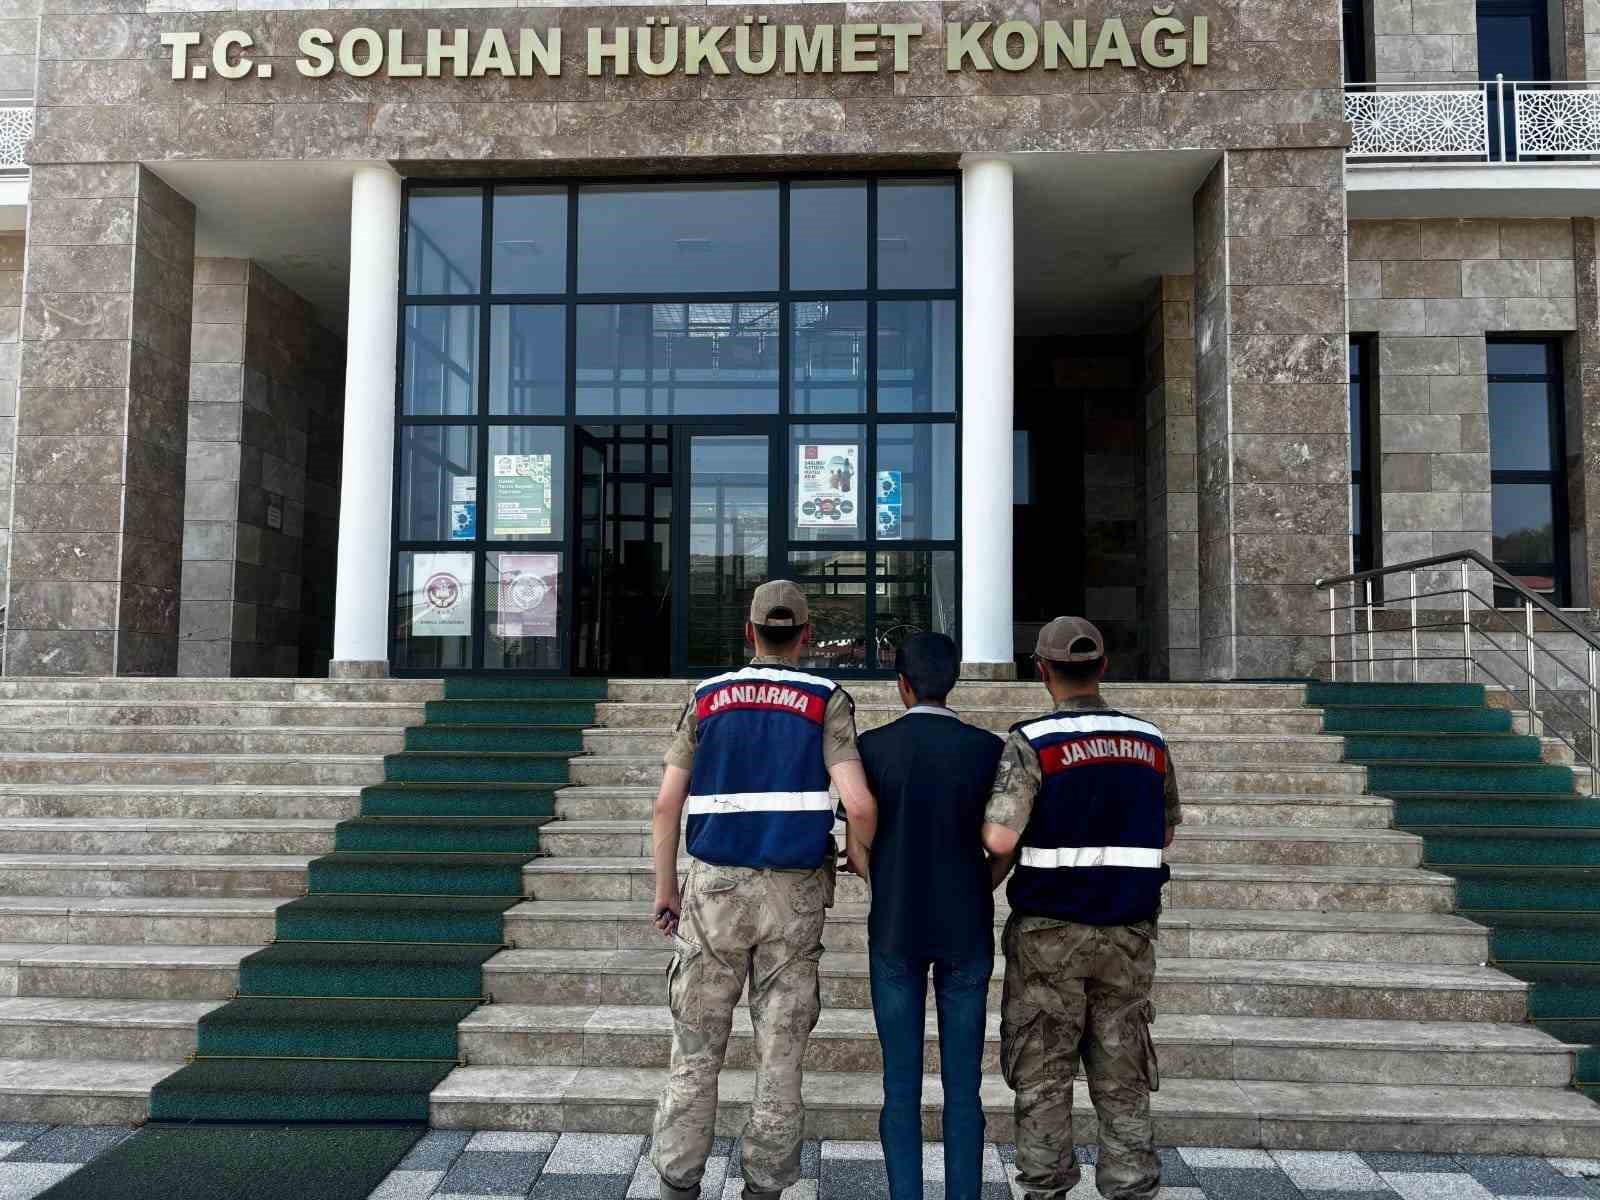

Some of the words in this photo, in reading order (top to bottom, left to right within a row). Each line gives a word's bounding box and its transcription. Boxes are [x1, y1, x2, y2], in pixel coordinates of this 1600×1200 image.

[160, 30, 273, 80] T.C.
[295, 27, 563, 78] SOLHAN
[587, 15, 923, 76] HÜKÜMET
[946, 4, 1209, 72] KONAĞI
[709, 685, 809, 713] JANDARMA
[1061, 738, 1156, 767] JANDARMA
